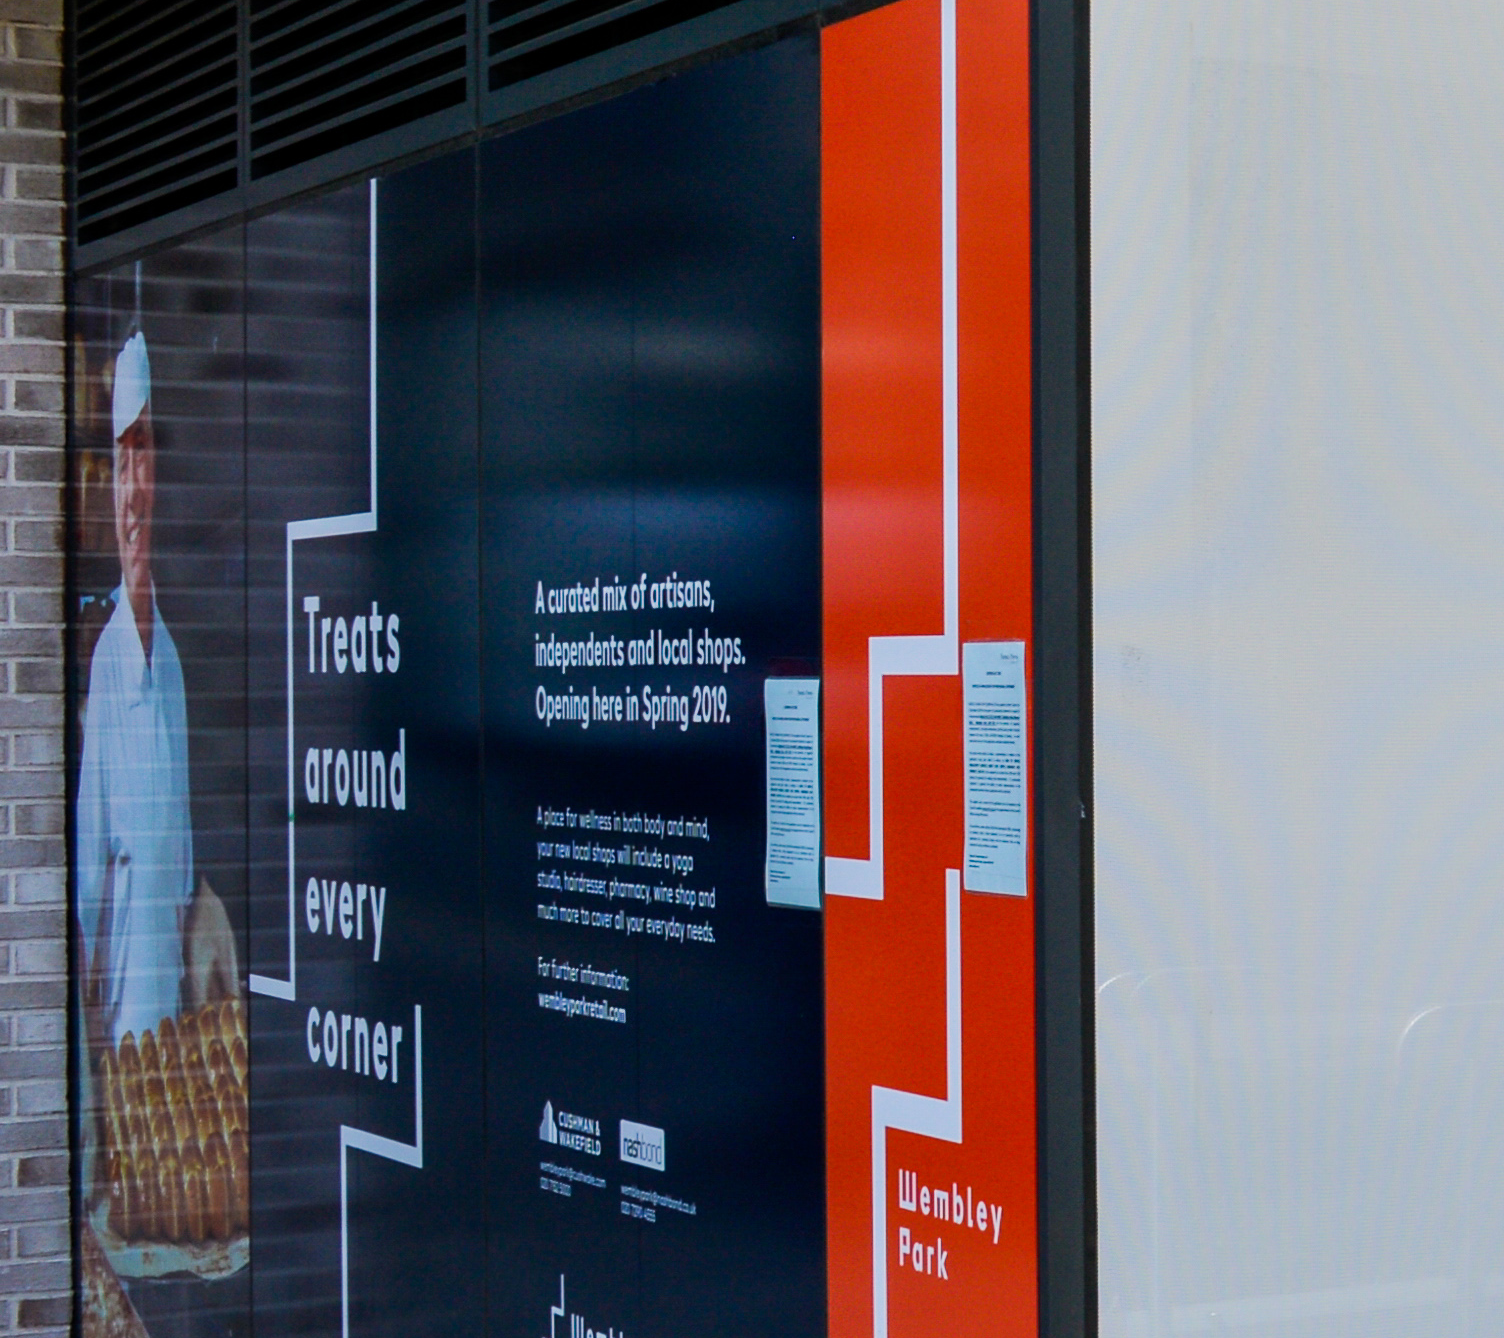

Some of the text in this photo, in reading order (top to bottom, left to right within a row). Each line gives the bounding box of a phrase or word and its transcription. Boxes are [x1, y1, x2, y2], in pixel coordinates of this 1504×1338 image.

[535, 571, 714, 614] A curated mix of artisans,
[304, 596, 400, 673] Treats
[535, 628, 746, 674] independents and local shops.
[536, 685, 730, 731] Opening here in Spring 2019.
[305, 728, 405, 810] around
[537, 806, 709, 842] A place for wellness in both body and mind,
[537, 840, 693, 876] your new local shops will include a yoga
[537, 869, 715, 910] studio, hairdresser, pharmacy, wine shop and
[306, 877, 386, 962] every
[537, 902, 715, 943] much more to cover all your everyday needs.
[538, 956, 629, 991] For further information:
[538, 991, 626, 1023] wembleyparkretail.com
[307, 1006, 402, 1083] corner
[559, 1111, 594, 1133] CUSHMAN
[559, 1130, 601, 1156] WAKEFIELD
[899, 1169, 1002, 1244] Wembley
[899, 1227, 948, 1280] Park
